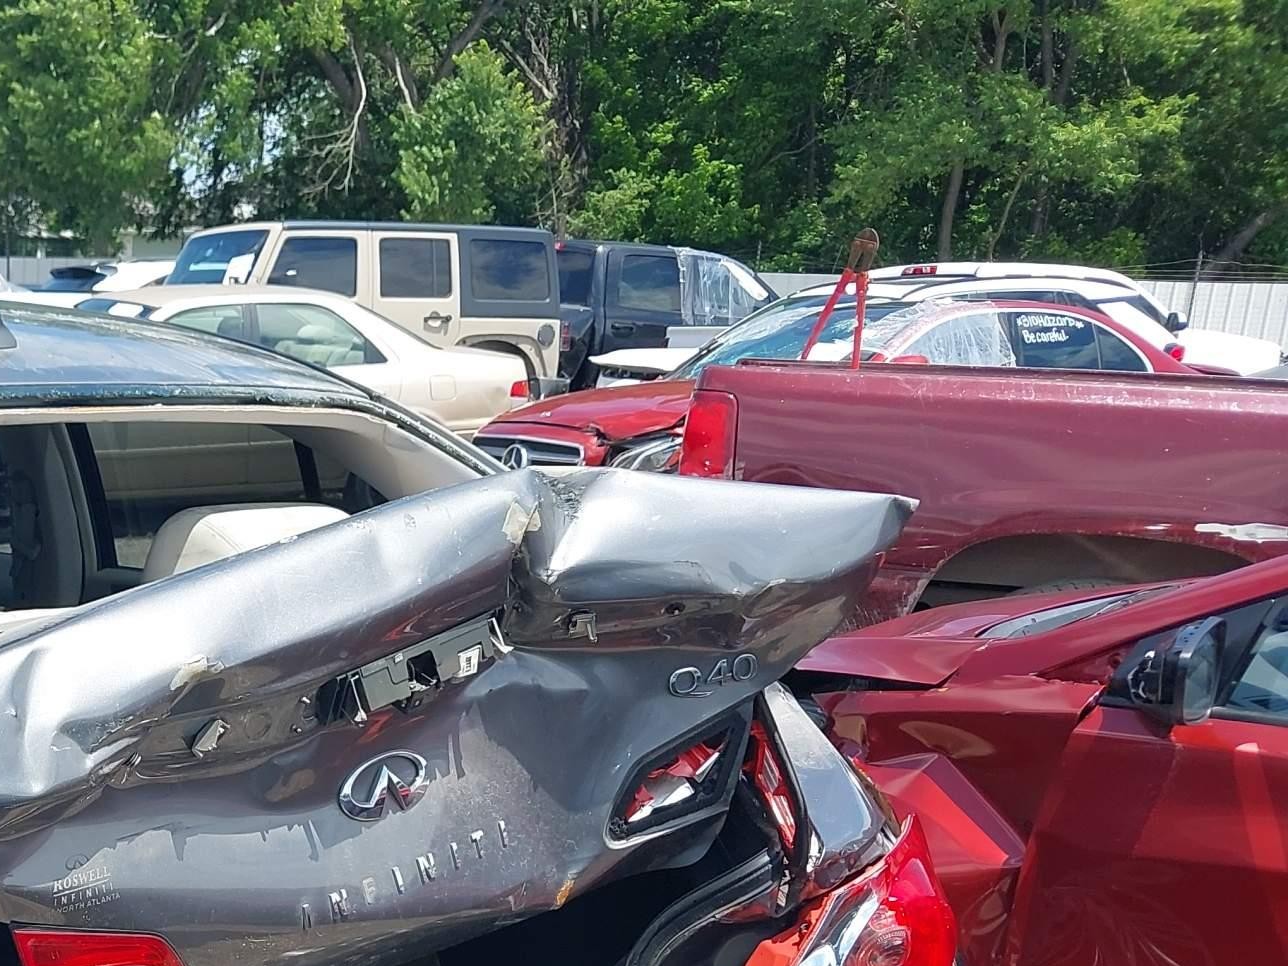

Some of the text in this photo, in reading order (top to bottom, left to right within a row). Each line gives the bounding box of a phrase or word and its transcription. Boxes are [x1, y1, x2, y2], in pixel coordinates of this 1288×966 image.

[1022, 329, 1037, 343] Be
[669, 653, 758, 697] Q40
[53, 866, 112, 893] ROSWELL
[300, 819, 509, 931] INFINITI
[54, 881, 114, 907] INFINITI
[57, 892, 121, 913] NORTH ATLANTA
